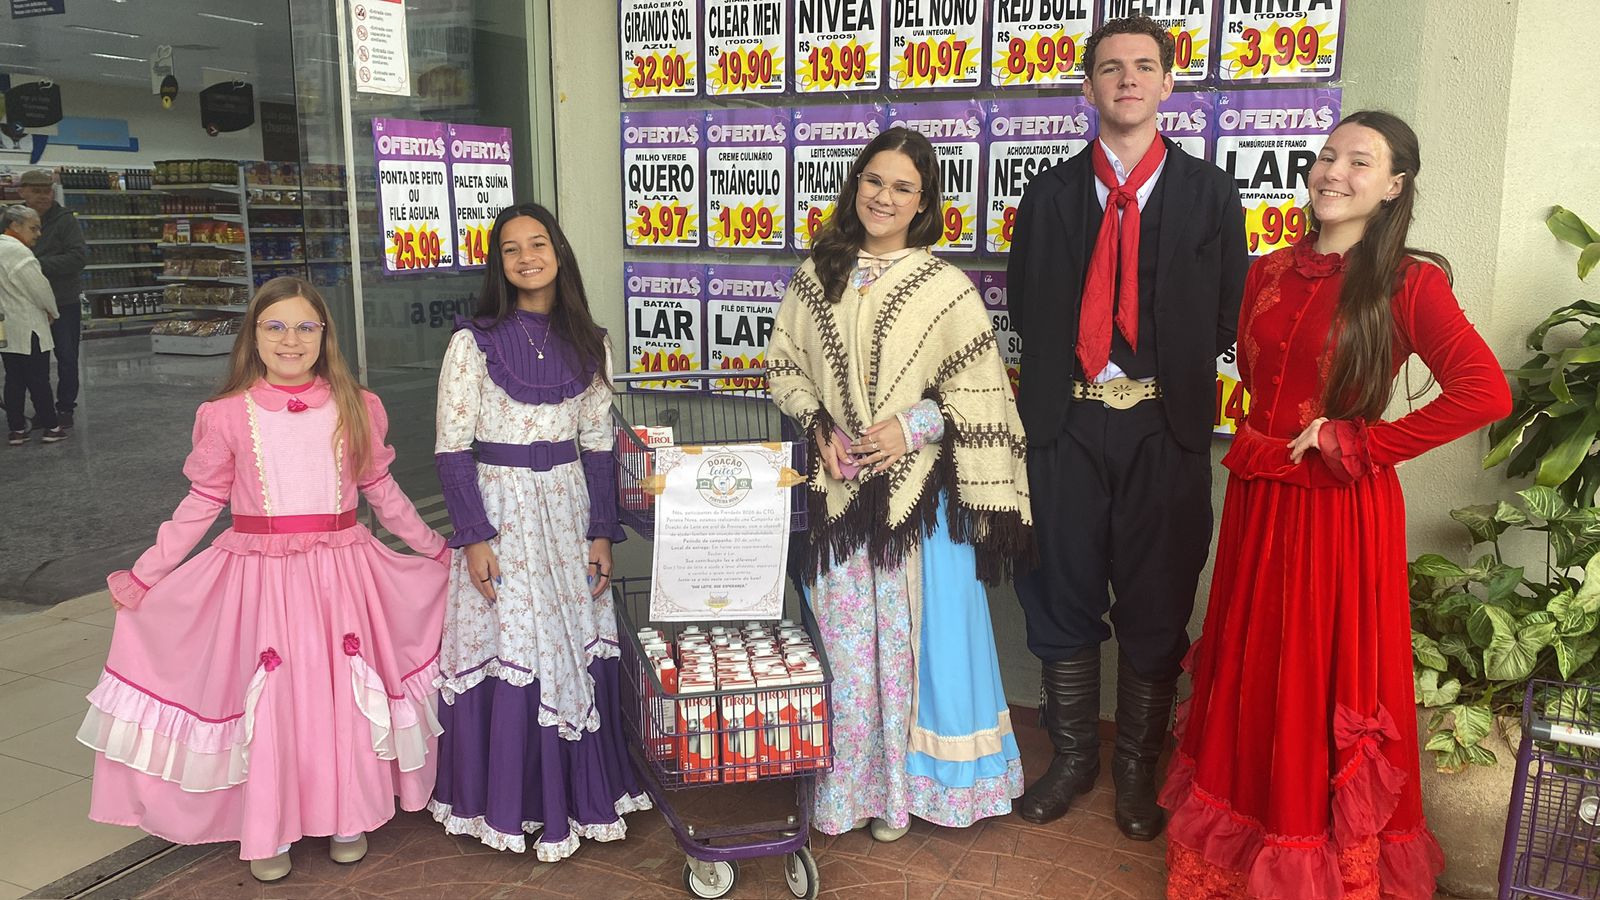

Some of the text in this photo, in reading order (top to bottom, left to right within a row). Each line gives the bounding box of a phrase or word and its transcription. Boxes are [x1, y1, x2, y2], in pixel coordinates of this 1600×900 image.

[709, 2, 780, 38] CLEAR MEN
[799, 0, 875, 34] NIVEA
[894, 0, 977, 28] DEL NONO
[998, 0, 1087, 23] RED BULL
[1254, 12, 1308, 20] (TODOS)
[624, 8, 691, 43] GIRANDO SOL
[913, 28, 955, 37] UVA INTEGRAL
[1018, 23, 1064, 32] (TODOS)
[1172, 19, 1186, 27] FORTE
[725, 38, 763, 46] (TODOS)
[817, 33, 856, 42] (TODOS)
[997, 31, 1076, 82] R$ 8,99
[1229, 21, 1332, 75] R$ 3,99 350G
[709, 46, 719, 56] R$
[718, 50, 772, 92] 19,90
[799, 41, 810, 52] R$
[808, 45, 866, 89] 13,99
[894, 36, 905, 47] R$
[903, 40, 967, 86] 10,97
[625, 50, 634, 60] R$
[633, 54, 686, 94] 32,90
[990, 112, 1089, 136] OFERTA$
[1219, 106, 1334, 130] OFERTA$
[623, 124, 700, 144] OFERTA$
[707, 122, 787, 144] OFERTA$
[794, 119, 880, 142] OFERTA$
[377, 135, 446, 160] OFERTA$
[451, 140, 511, 162] OFERTA$
[811, 148, 826, 158] LEITE
[938, 146, 963, 155] TOMATE
[1007, 142, 1069, 155] ACHOCOLATADO EM PÓ
[1238, 139, 1307, 148] HAMBÚRGUER DE FRANGO
[661, 153, 687, 161] VERDE
[718, 150, 772, 161] CREME CULINÁRIO
[381, 170, 443, 185] PONTA DE PEITO
[628, 163, 694, 194] QUERO
[710, 163, 780, 195] TRIÂNGULO
[940, 159, 973, 192] INI
[1226, 150, 1317, 189] LAR
[454, 173, 508, 188] PALETA SUÍNA
[408, 189, 420, 203] OU
[477, 191, 489, 204] OU
[798, 201, 808, 211] R$
[992, 200, 1004, 211] R$
[389, 203, 440, 221] FILÉ AGULHA
[457, 204, 505, 220] PERNIL SUÍ
[629, 200, 638, 209] R$
[637, 205, 688, 244] 3,97
[710, 200, 720, 210] R$
[719, 206, 773, 245] 1,99
[386, 230, 394, 238] R$
[394, 231, 440, 269] 25,99
[627, 276, 701, 296] OFERTA$
[411, 302, 426, 324] a
[643, 300, 682, 309] BATATA
[721, 303, 773, 314] FILÉ DE TILÁPIA
[635, 308, 695, 340] LAR
[715, 314, 775, 347] LAR
[632, 345, 642, 355] R$
[712, 350, 722, 360] R$
[648, 436, 672, 444] TIROL
[708, 458, 742, 467] DOAÇÃO
[723, 696, 755, 707] TIROL
